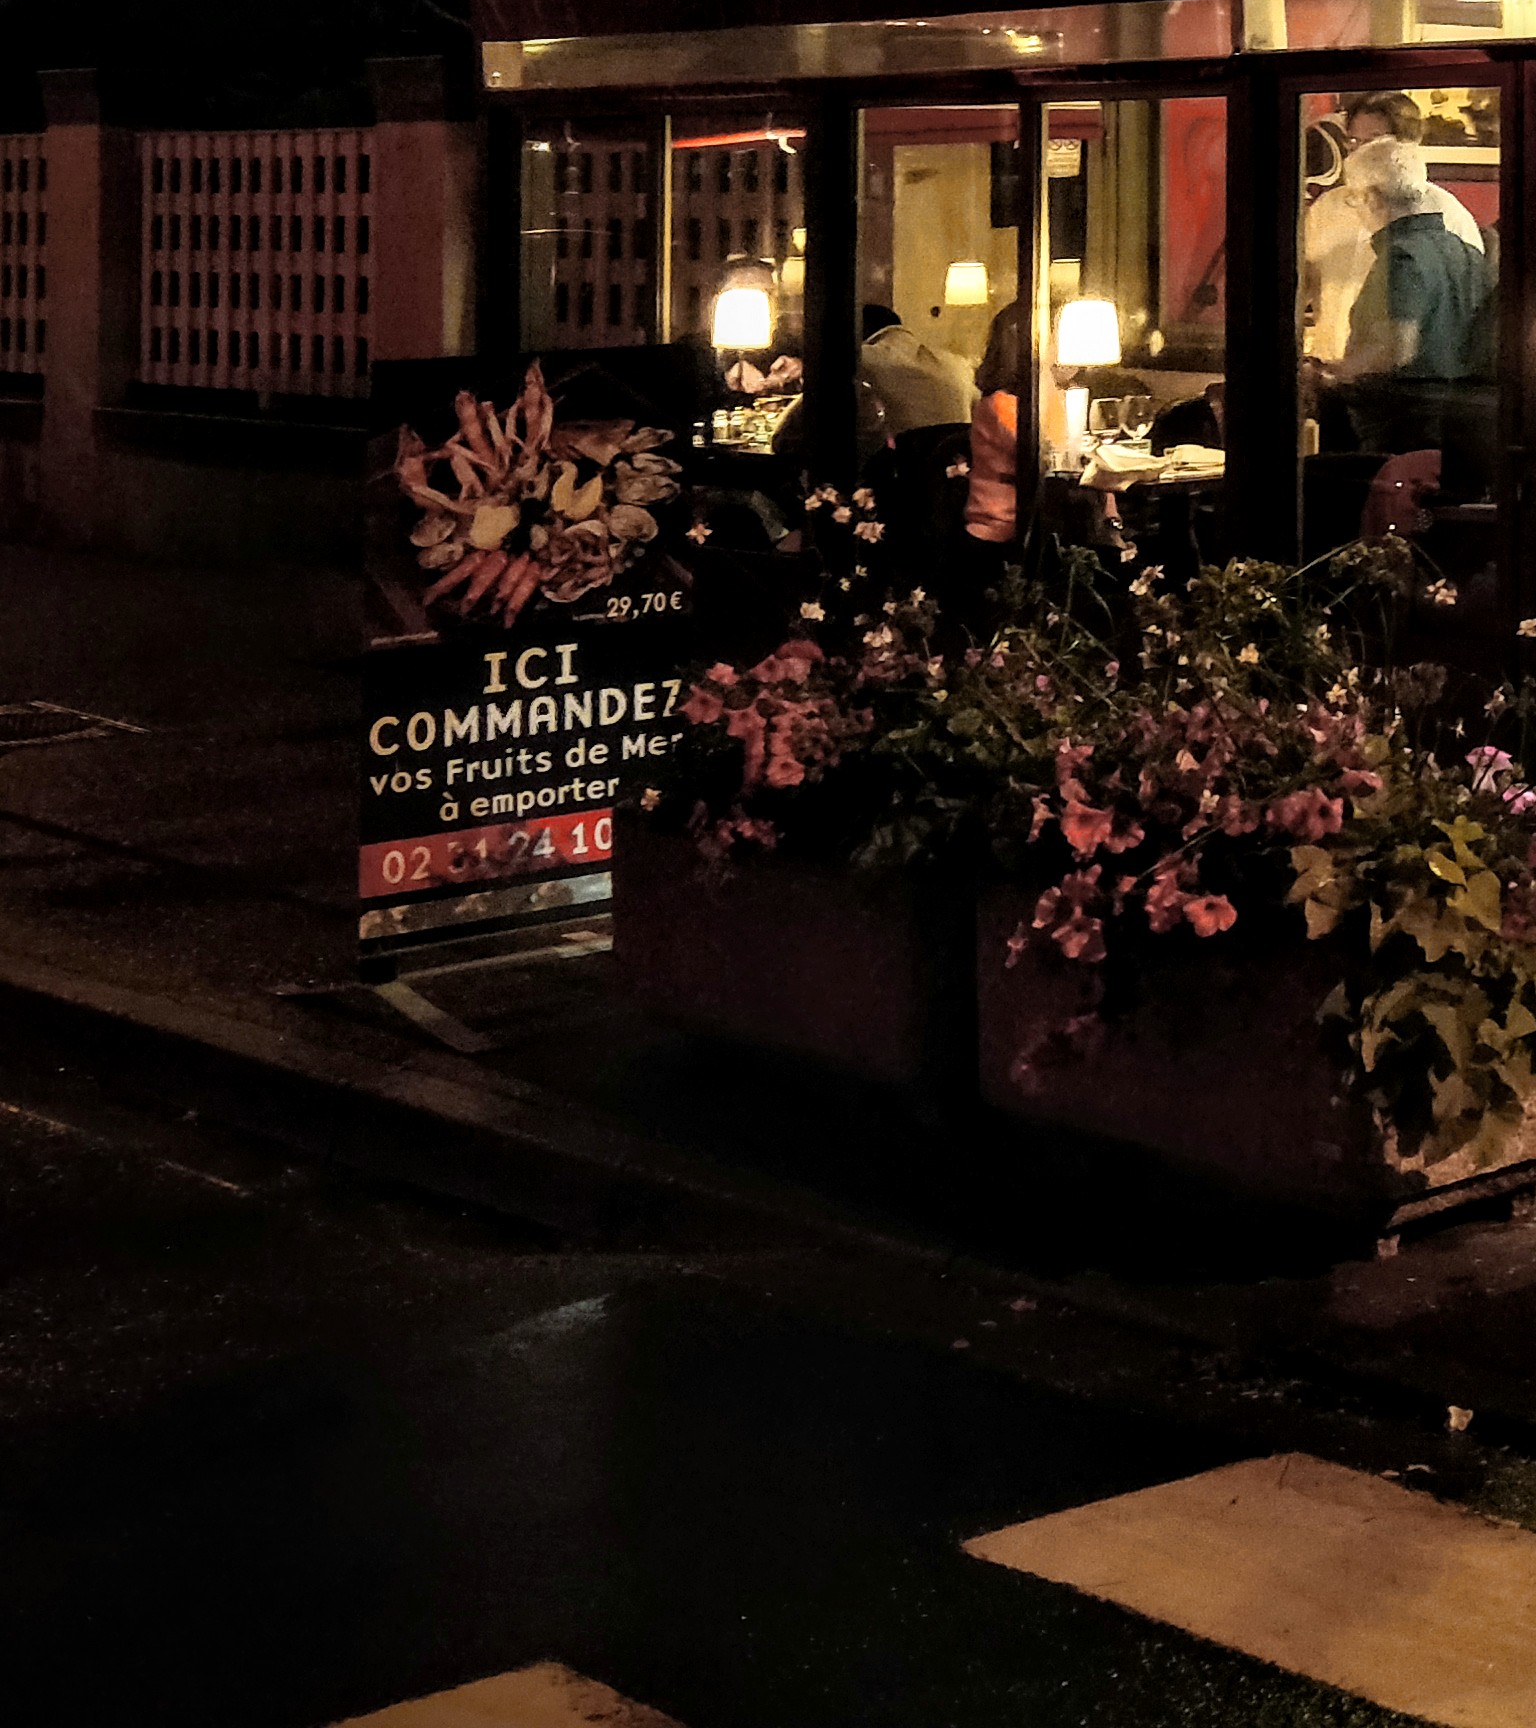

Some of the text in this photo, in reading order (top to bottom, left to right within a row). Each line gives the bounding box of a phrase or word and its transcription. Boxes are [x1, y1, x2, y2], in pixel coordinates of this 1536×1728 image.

[483, 643, 579, 695] ICI
[369, 678, 683, 757] COMMANDEZ
[370, 768, 433, 796] vos
[446, 746, 553, 786] Fruits
[565, 738, 609, 768] de
[439, 776, 621, 822] à emporter
[382, 845, 432, 885] 02
[507, 825, 556, 863] 24
[570, 816, 613, 856] 10
